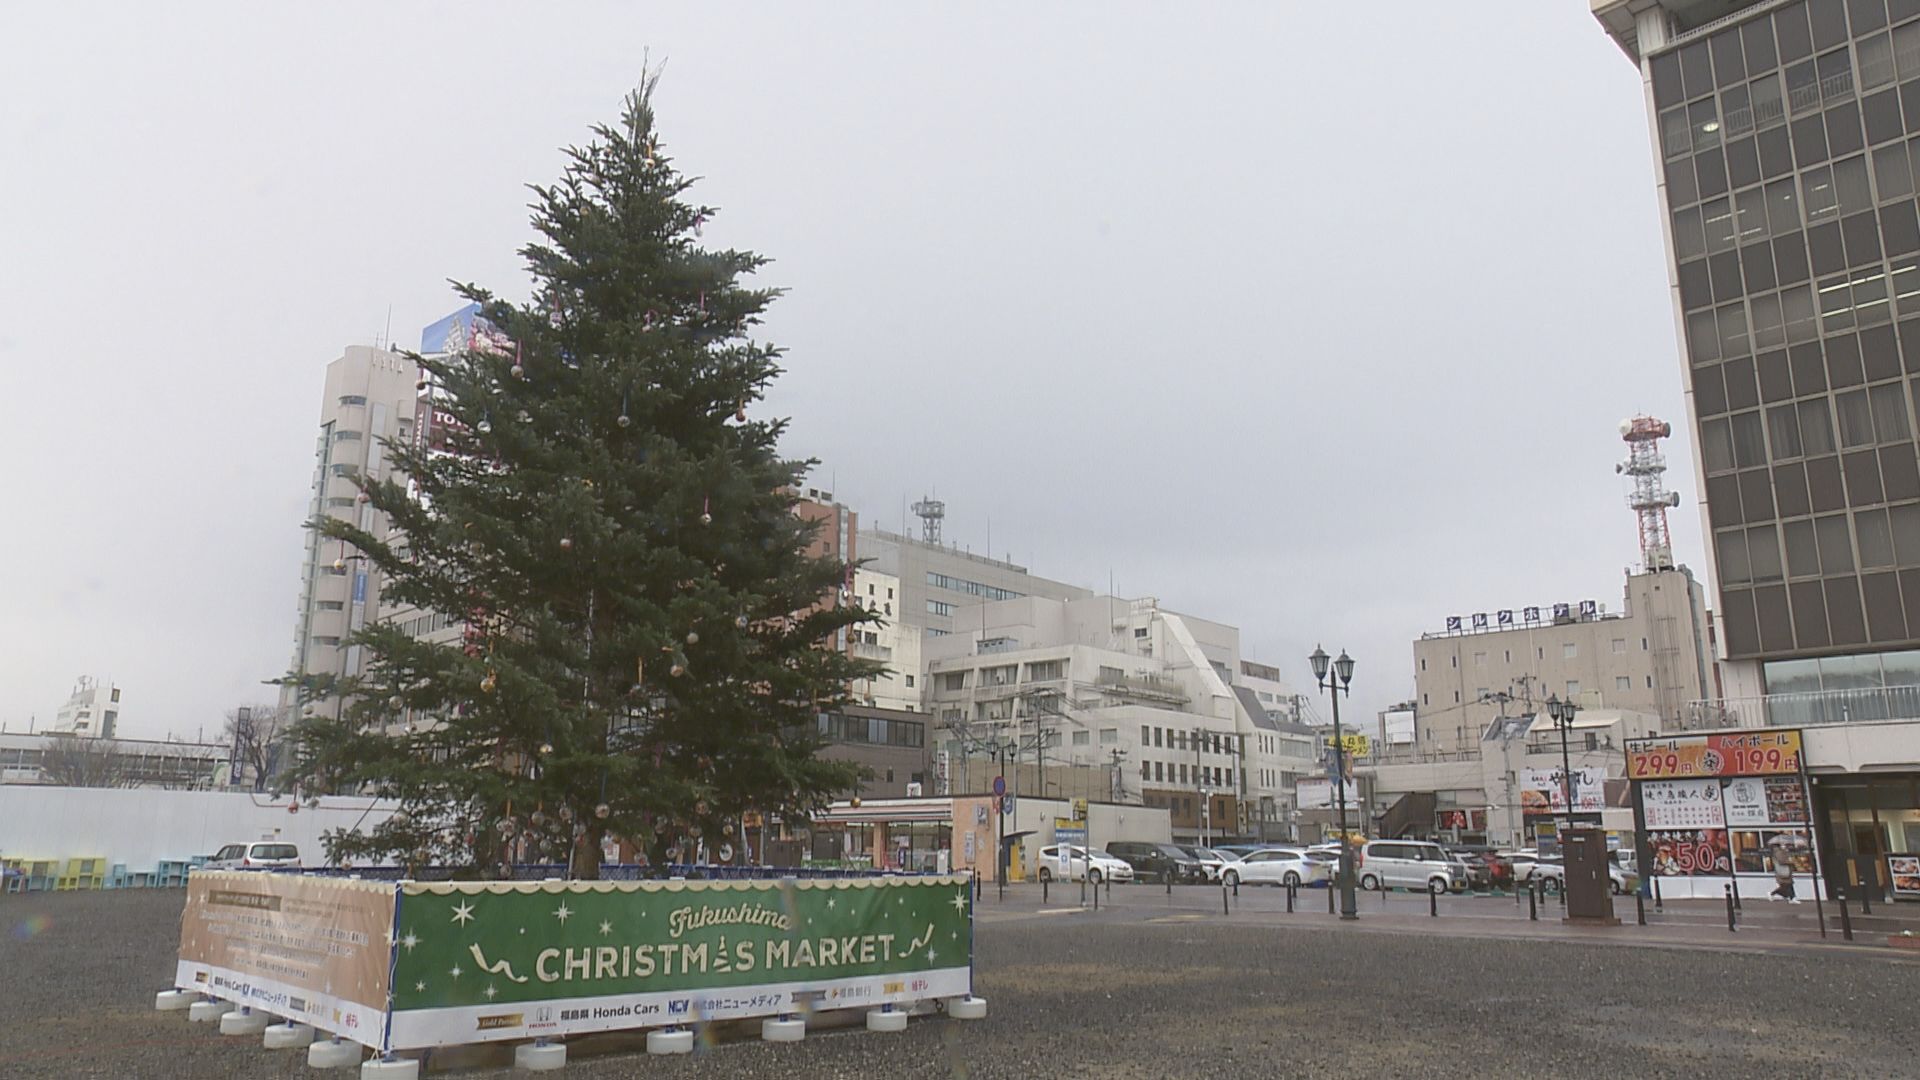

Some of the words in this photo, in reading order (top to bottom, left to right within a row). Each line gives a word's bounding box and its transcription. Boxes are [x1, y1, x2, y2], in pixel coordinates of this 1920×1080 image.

[1447, 602, 1595, 629] シルクホテル
[1629, 739, 1680, 754] 生ビール
[1721, 733, 1789, 749] ハイボール
[1549, 771, 1594, 786] やし
[669, 902, 791, 939] Fukushima
[765, 934, 895, 970] MARKET
[560, 1009, 589, 1021] 福島県
[593, 1006, 631, 1020] Honda
[634, 1003, 660, 1015] Cars
